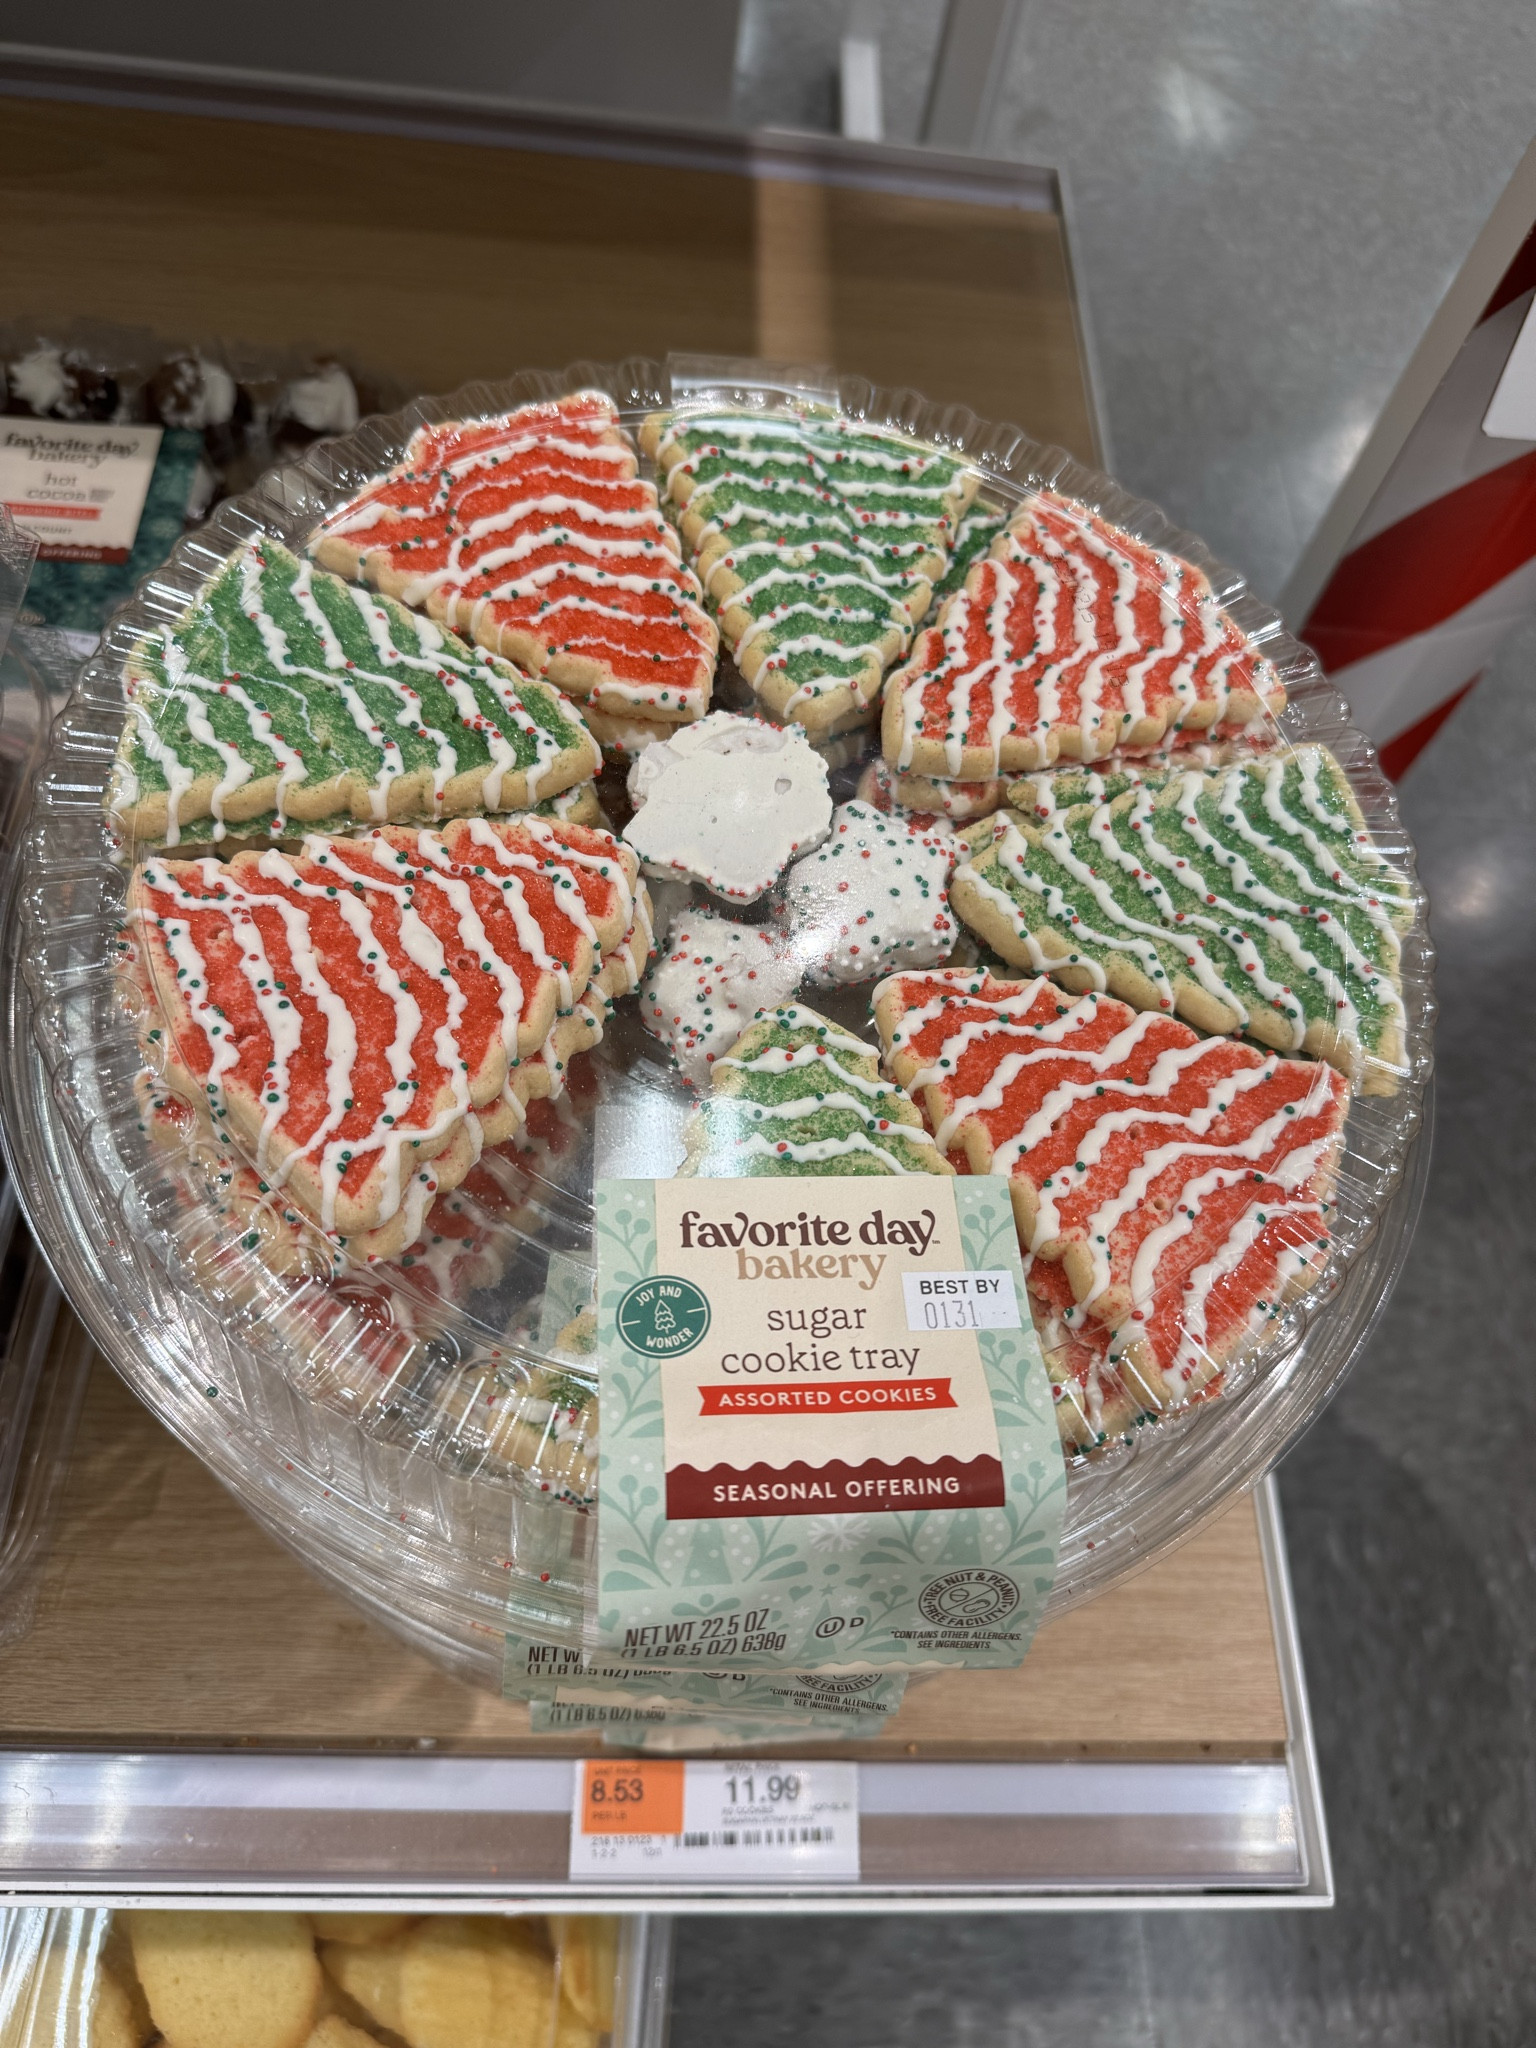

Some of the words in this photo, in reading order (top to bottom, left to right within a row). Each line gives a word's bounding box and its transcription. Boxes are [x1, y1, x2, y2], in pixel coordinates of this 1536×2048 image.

[5, 432, 94, 450] favorite
[97, 440, 140, 459] day
[45, 470, 77, 486] hot
[26, 489, 86, 501] cocoa
[680, 1210, 851, 1249] favorite
[736, 1248, 887, 1291] bakery
[635, 1287, 655, 1307] JOY
[659, 1285, 682, 1299] AND
[919, 1279, 969, 1295] BEST
[975, 1279, 1000, 1294] BY
[767, 1306, 868, 1338] sugar
[924, 1299, 980, 1330] 0131
[645, 1327, 694, 1349] WONDER
[720, 1343, 842, 1375] cookie
[850, 1346, 920, 1376] tray
[718, 1390, 832, 1408] ASSORTED
[839, 1386, 937, 1405] COOKIES
[712, 1481, 837, 1502] SEASONAL
[844, 1476, 960, 1498] OFFERING
[923, 1582, 947, 1603] TREE
[943, 1571, 974, 1587] NUT
[986, 1573, 1015, 1606] PEANUT
[923, 1603, 947, 1623] FREE
[947, 1607, 1006, 1627] FACILITY
[624, 1625, 662, 1648] NET
[665, 1620, 697, 1643] WT
[699, 1613, 740, 1640] 22.5
[744, 1607, 770, 1634] OZ
[940, 1630, 969, 1640] OTHER
[970, 1631, 1022, 1641] ALLERGENS.
[528, 1646, 560, 1662] NET
[563, 1648, 580, 1663] W
[621, 1646, 637, 1659] (1
[644, 1645, 668, 1659] LB
[673, 1642, 702, 1658] 6.5
[707, 1637, 737, 1656] OZ)
[741, 1631, 787, 1654] 638g
[917, 1640, 933, 1649] SEE
[934, 1640, 992, 1649] INGREDIENTS
[527, 1664, 541, 1676] (1
[547, 1663, 569, 1675] LB
[793, 1698, 809, 1707] SEE
[809, 1700, 861, 1714] INGREDIENTS
[814, 1693, 841, 1704] OTHER
[841, 1698, 889, 1712] ALLERGENS.
[590, 1777, 645, 1802] 8.53
[726, 1774, 801, 1804] 11.99
